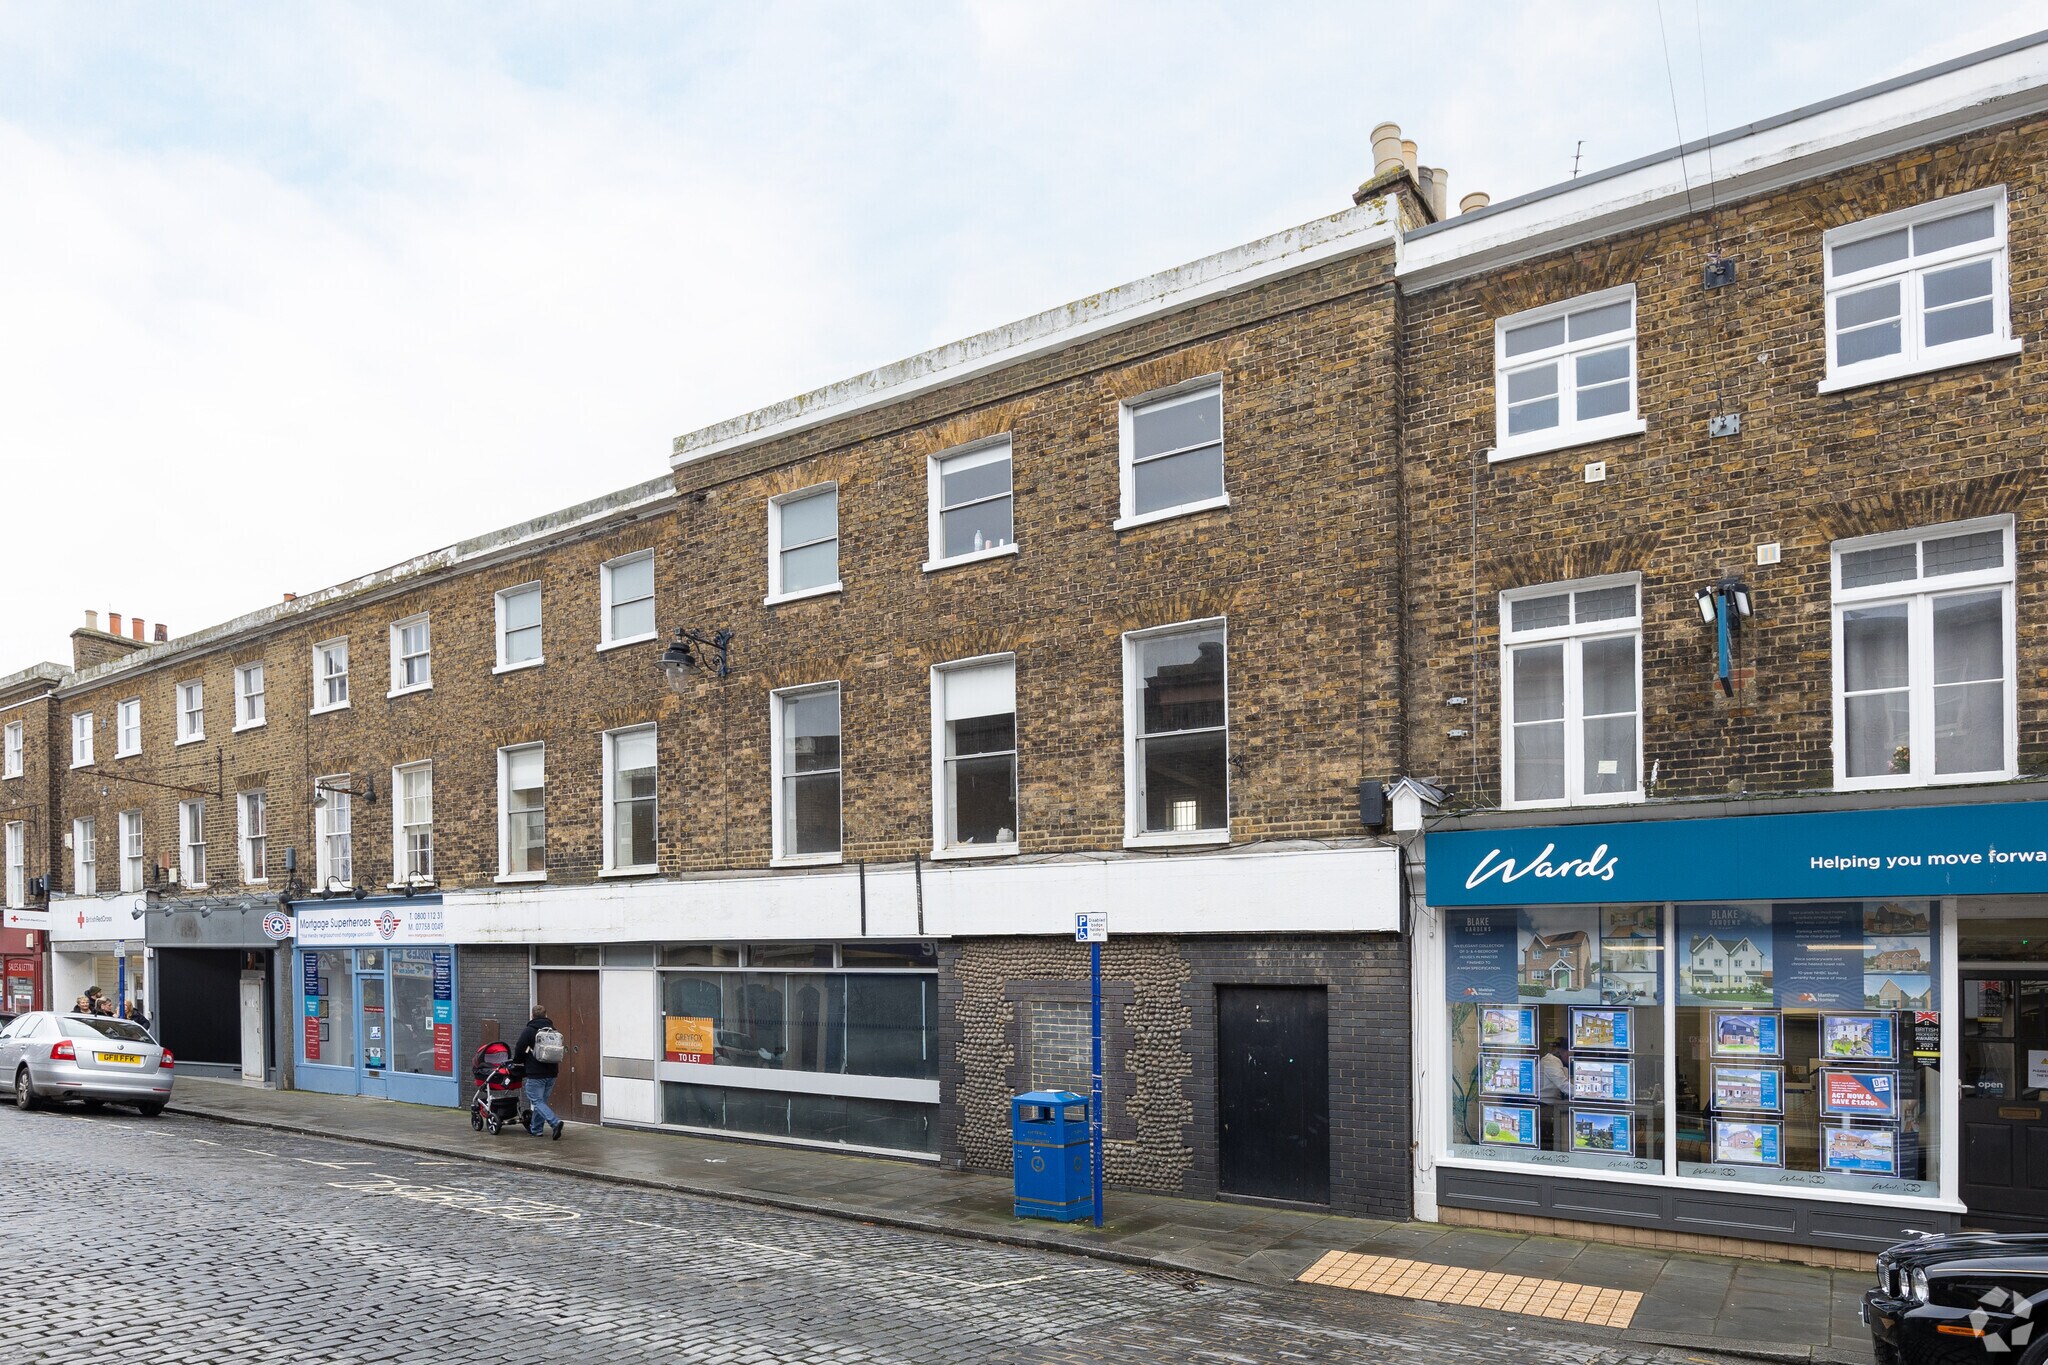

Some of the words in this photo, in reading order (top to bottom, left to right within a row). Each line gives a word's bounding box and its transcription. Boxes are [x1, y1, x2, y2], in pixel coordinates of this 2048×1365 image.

[1810, 855, 1880, 870] Helping
[1886, 855, 1921, 869] you
[1928, 852, 1982, 865] move
[1466, 843, 1618, 889] Wards
[1711, 909, 1738, 919] BLAKE
[300, 919, 328, 930] Mortgage
[330, 918, 371, 928] Superheroes
[1466, 917, 1489, 926] BLAKE
[675, 1033, 703, 1041] GREYFOX
[679, 1053, 687, 1062] TO
[688, 1054, 701, 1062] LET
[1978, 1081, 2003, 1089] open
